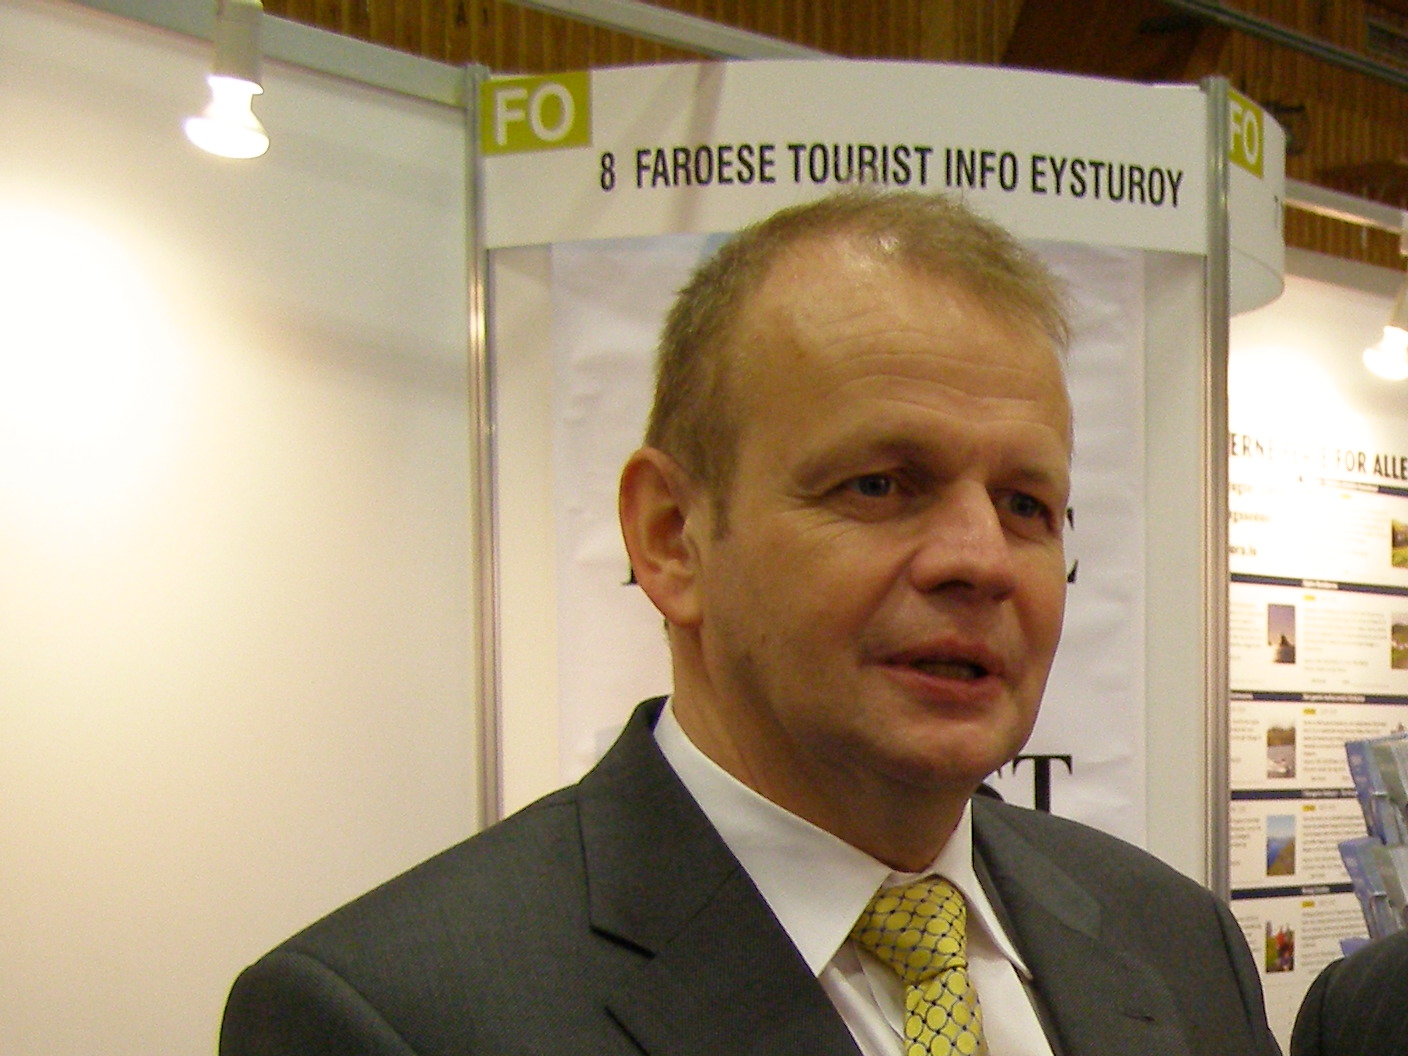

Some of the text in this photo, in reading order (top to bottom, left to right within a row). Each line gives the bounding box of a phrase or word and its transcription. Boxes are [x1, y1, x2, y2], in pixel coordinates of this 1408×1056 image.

[495, 82, 575, 147] FO
[1229, 100, 1259, 166] FO
[600, 143, 1184, 208] 8 FAROESE TOURIST INFO EYSTUROY
[1336, 447, 1367, 475] FOR
[1373, 453, 1408, 481] ALLE
